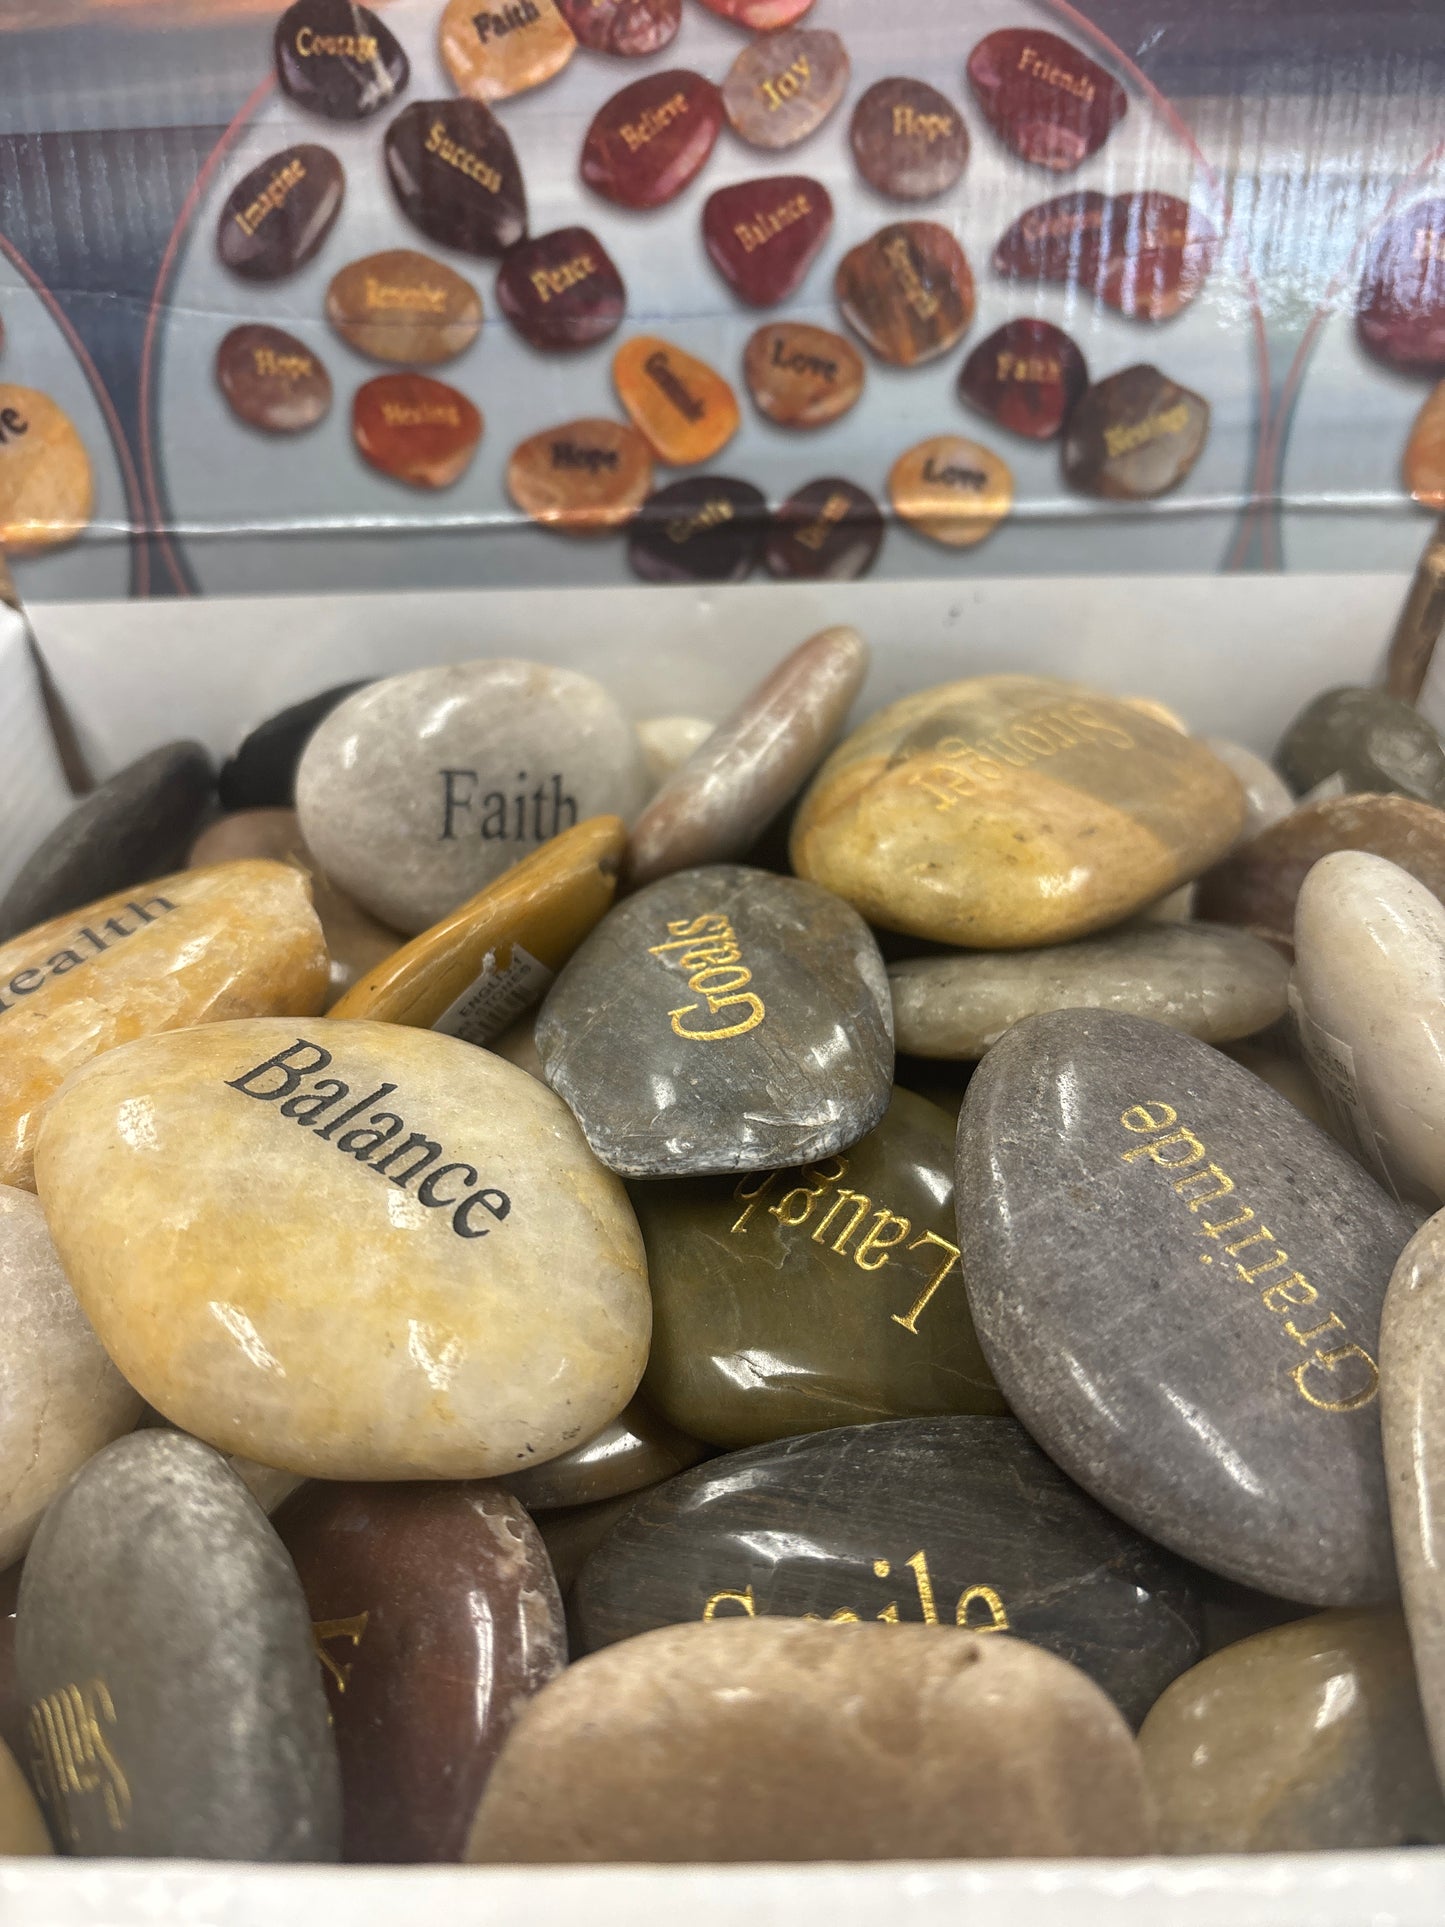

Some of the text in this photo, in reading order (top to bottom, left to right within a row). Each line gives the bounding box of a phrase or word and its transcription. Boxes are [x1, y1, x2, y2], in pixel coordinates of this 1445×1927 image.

[295, 26, 379, 64] Courage
[1016, 46, 1096, 102] Friends
[760, 54, 813, 113] Joy
[618, 92, 690, 154] Believe
[892, 104, 952, 143] Hope
[424, 120, 503, 195] Success
[233, 157, 307, 238] Imagine
[733, 193, 815, 254] Balance
[530, 254, 597, 304] Peace
[253, 346, 314, 381] Hope
[771, 337, 839, 384] Love
[551, 441, 619, 477] Hope
[921, 457, 989, 492] Love
[438, 767, 578, 842] Faith
[0, 897, 180, 1014] ealth
[648, 912, 766, 1042] Goals
[224, 1037, 512, 1239] Balance
[730, 1154, 961, 1335] Laugh
[1119, 1099, 1380, 1413] Gratitude
